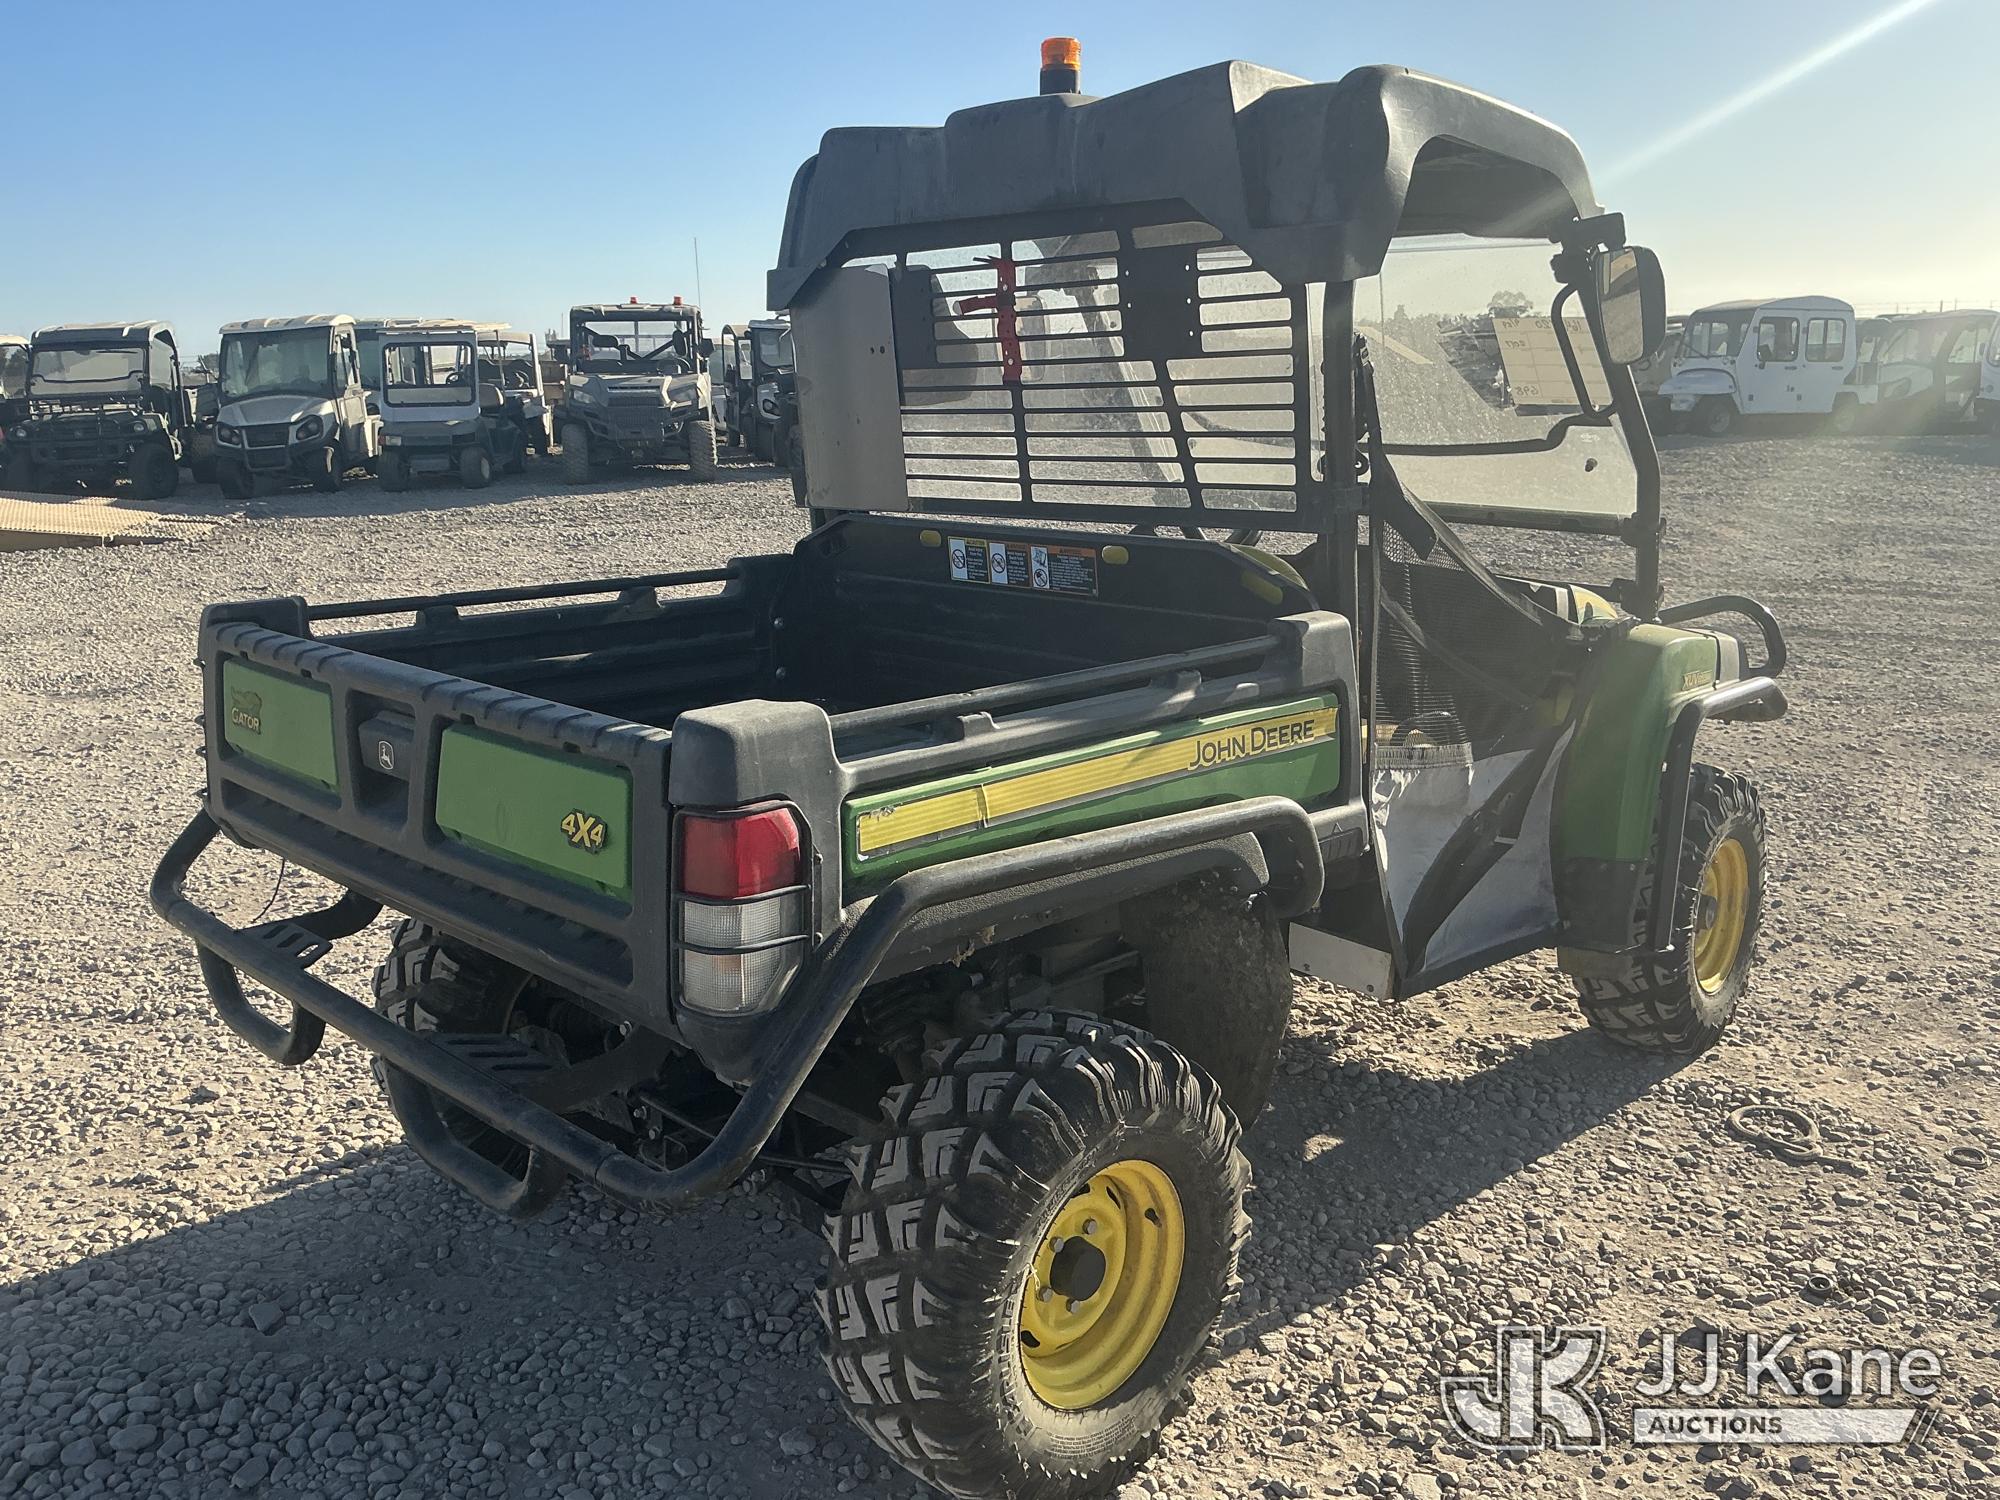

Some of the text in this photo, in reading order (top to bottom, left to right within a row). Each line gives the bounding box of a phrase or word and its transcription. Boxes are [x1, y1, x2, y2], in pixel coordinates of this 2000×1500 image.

[231, 707, 260, 731] GATOR
[1189, 719, 1315, 768] JOHN DEERE
[561, 811, 604, 848] 4X4
